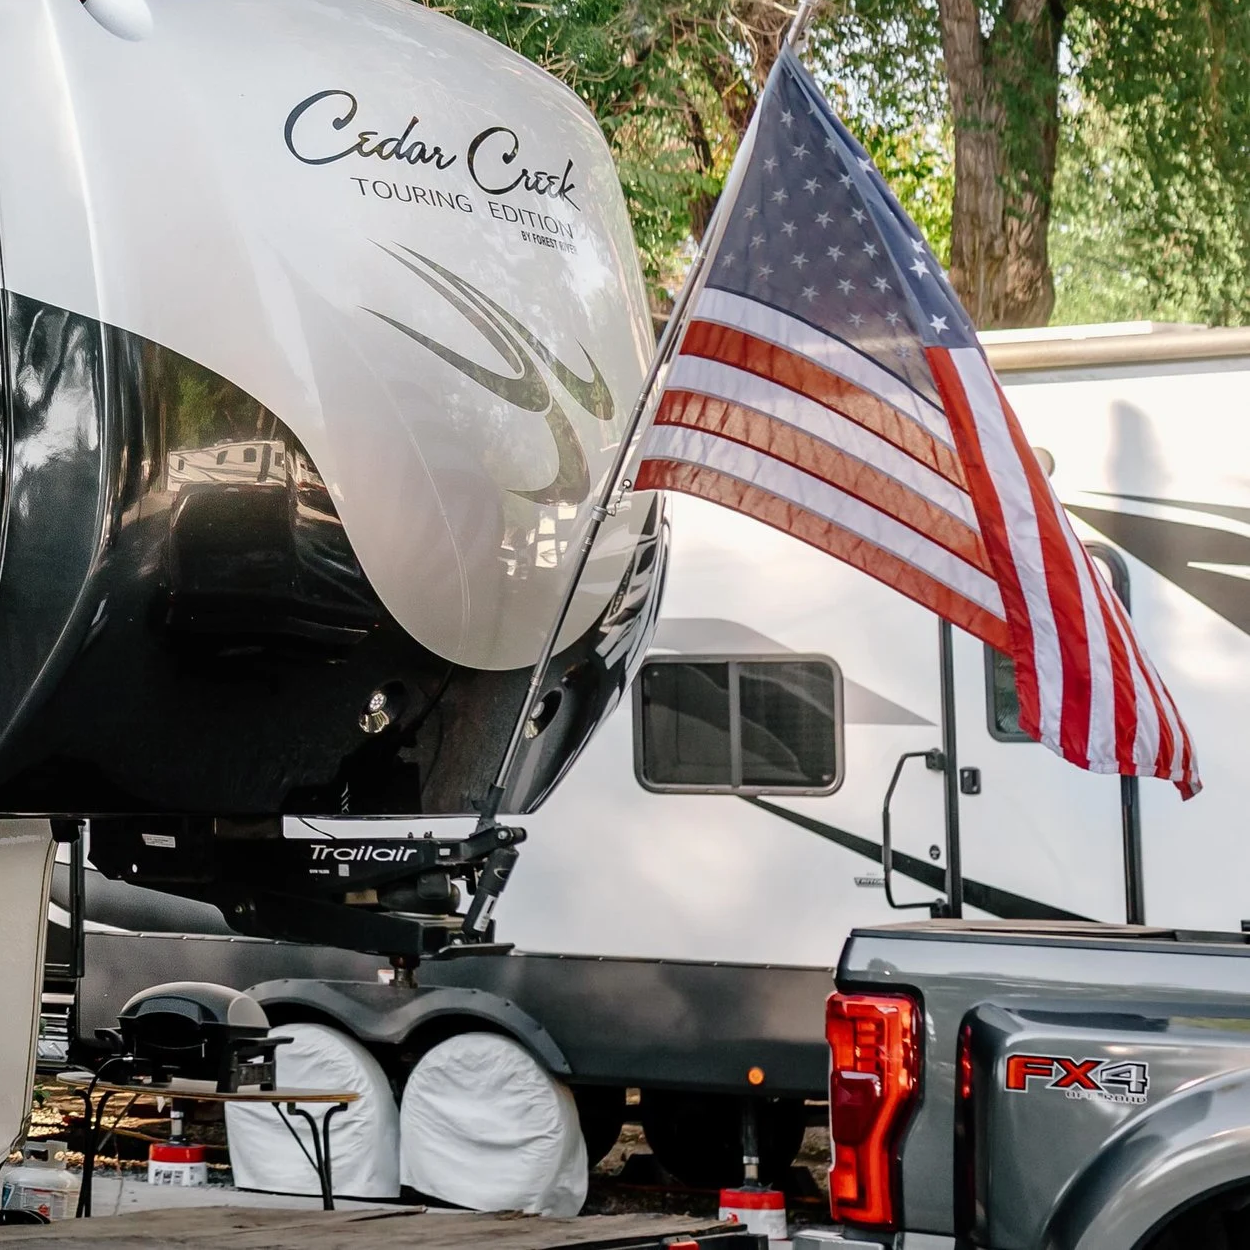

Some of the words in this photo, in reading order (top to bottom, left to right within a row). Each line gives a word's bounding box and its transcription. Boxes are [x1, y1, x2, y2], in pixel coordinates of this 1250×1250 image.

[284, 89, 456, 170] Cedar
[467, 126, 581, 212] Creek
[350, 177, 473, 213] TOURING
[488, 200, 574, 239] EDITION
[521, 230, 532, 242] BY
[532, 233, 559, 249] FOREST
[310, 844, 418, 862] Trailair
[1004, 1052, 1150, 1096] FX4
